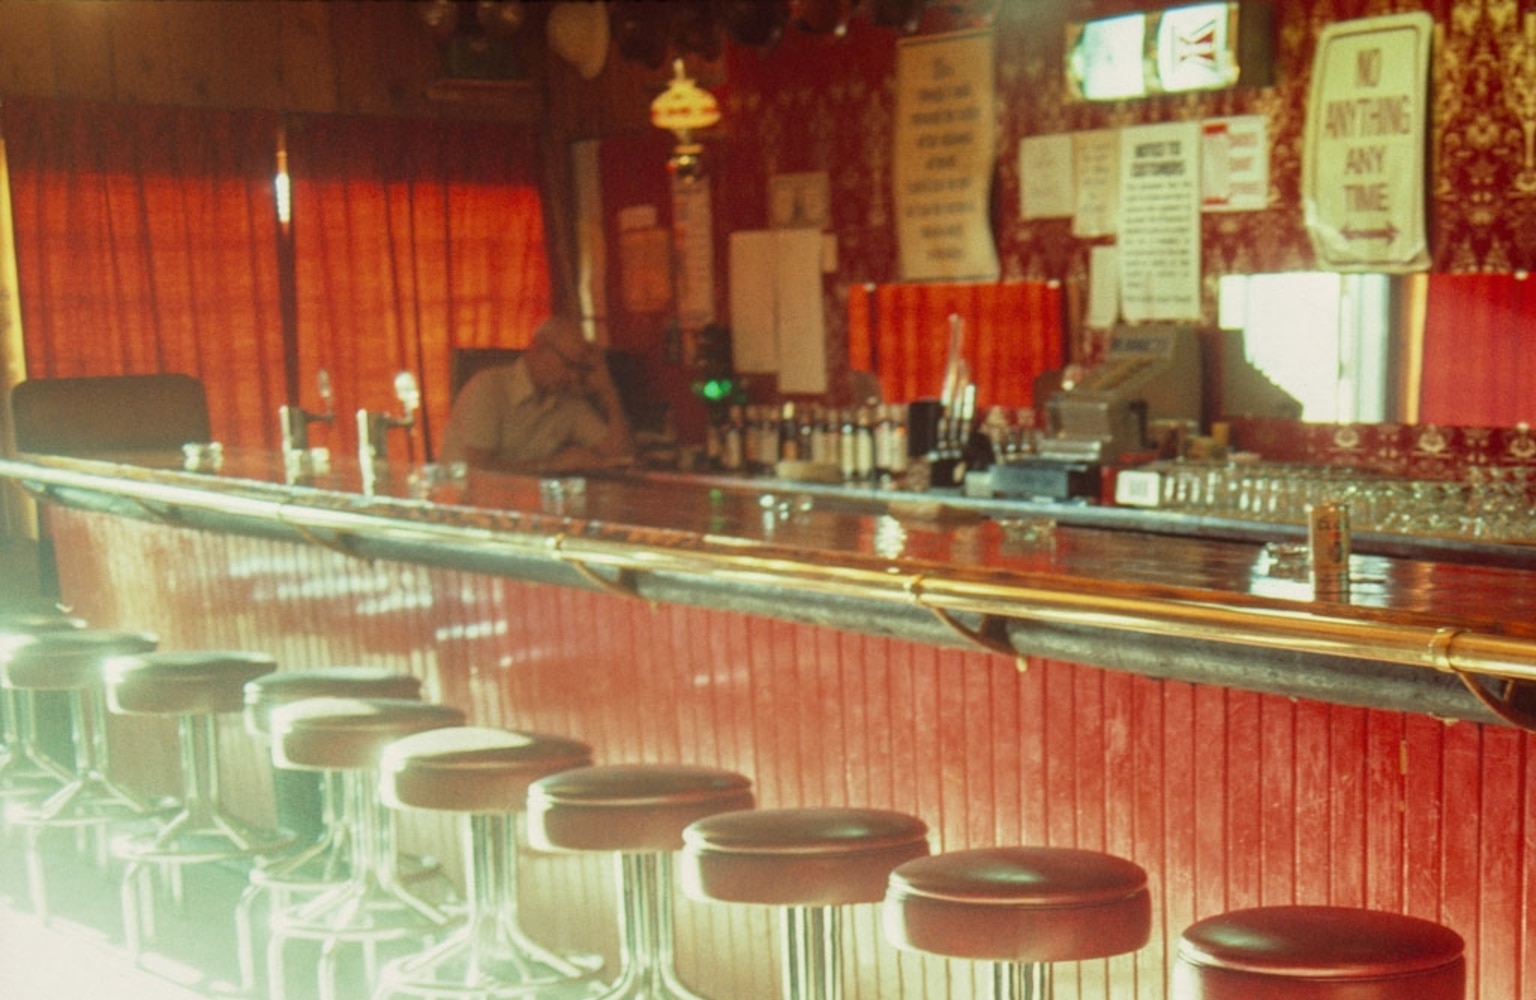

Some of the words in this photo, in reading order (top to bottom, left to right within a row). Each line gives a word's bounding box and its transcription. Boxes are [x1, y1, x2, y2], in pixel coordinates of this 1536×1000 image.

[1355, 48, 1382, 88] NO
[1323, 94, 1411, 139] ANYTHING
[1344, 145, 1386, 175] ANY
[1343, 182, 1390, 213] TIME
